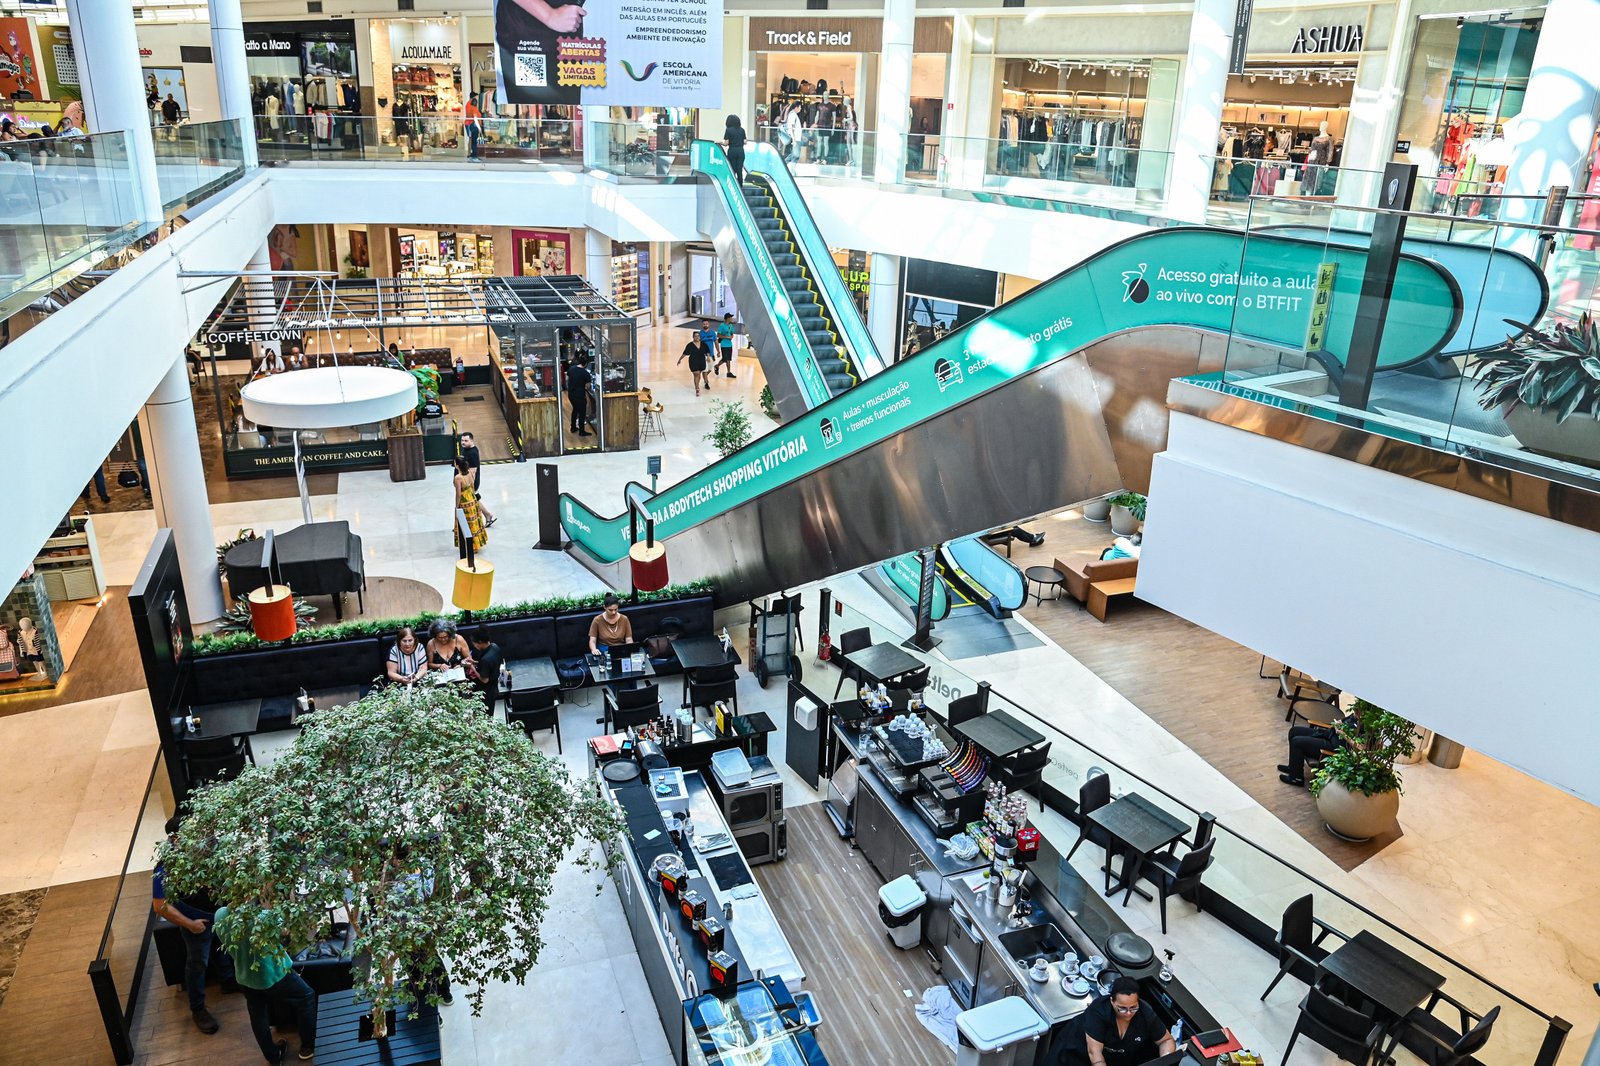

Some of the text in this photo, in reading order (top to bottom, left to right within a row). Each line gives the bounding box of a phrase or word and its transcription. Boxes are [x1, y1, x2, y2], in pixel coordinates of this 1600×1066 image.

[668, 16, 707, 24] PORTUGUÊS
[635, 27, 707, 36] EMPREENDEDORISMO
[245, 39, 291, 50] atto a Mano
[626, 34, 661, 42] AMBIENTE
[671, 36, 706, 44] INOVAÇÃO
[1289, 25, 1363, 53] ASHUA
[401, 46, 452, 59] ACQUAMARE
[560, 48, 600, 57] ABERTAS
[563, 67, 596, 75] VAGAS
[662, 61, 693, 69] ESCOLA
[662, 69, 708, 77] AMERICANA
[1157, 267, 1206, 283] Acesso
[1209, 271, 1269, 288] gratuito
[1272, 277, 1281, 288] a
[1156, 289, 1303, 312] ao vivo com o BTFIT
[1043, 317, 1073, 341] grátis
[208, 330, 301, 343] COFFEETOWN
[963, 350, 970, 361] 3
[843, 405, 862, 420] Aulas
[866, 381, 910, 409] musculação
[850, 415, 874, 432] treinos
[873, 396, 911, 421] funcionais
[254, 458, 270, 466] THE
[344, 451, 361, 459] AND
[663, 506, 670, 522] A
[669, 484, 713, 518] BODYTECH
[714, 458, 762, 496] SHOPPING
[762, 435, 808, 472] VITÓRIA
